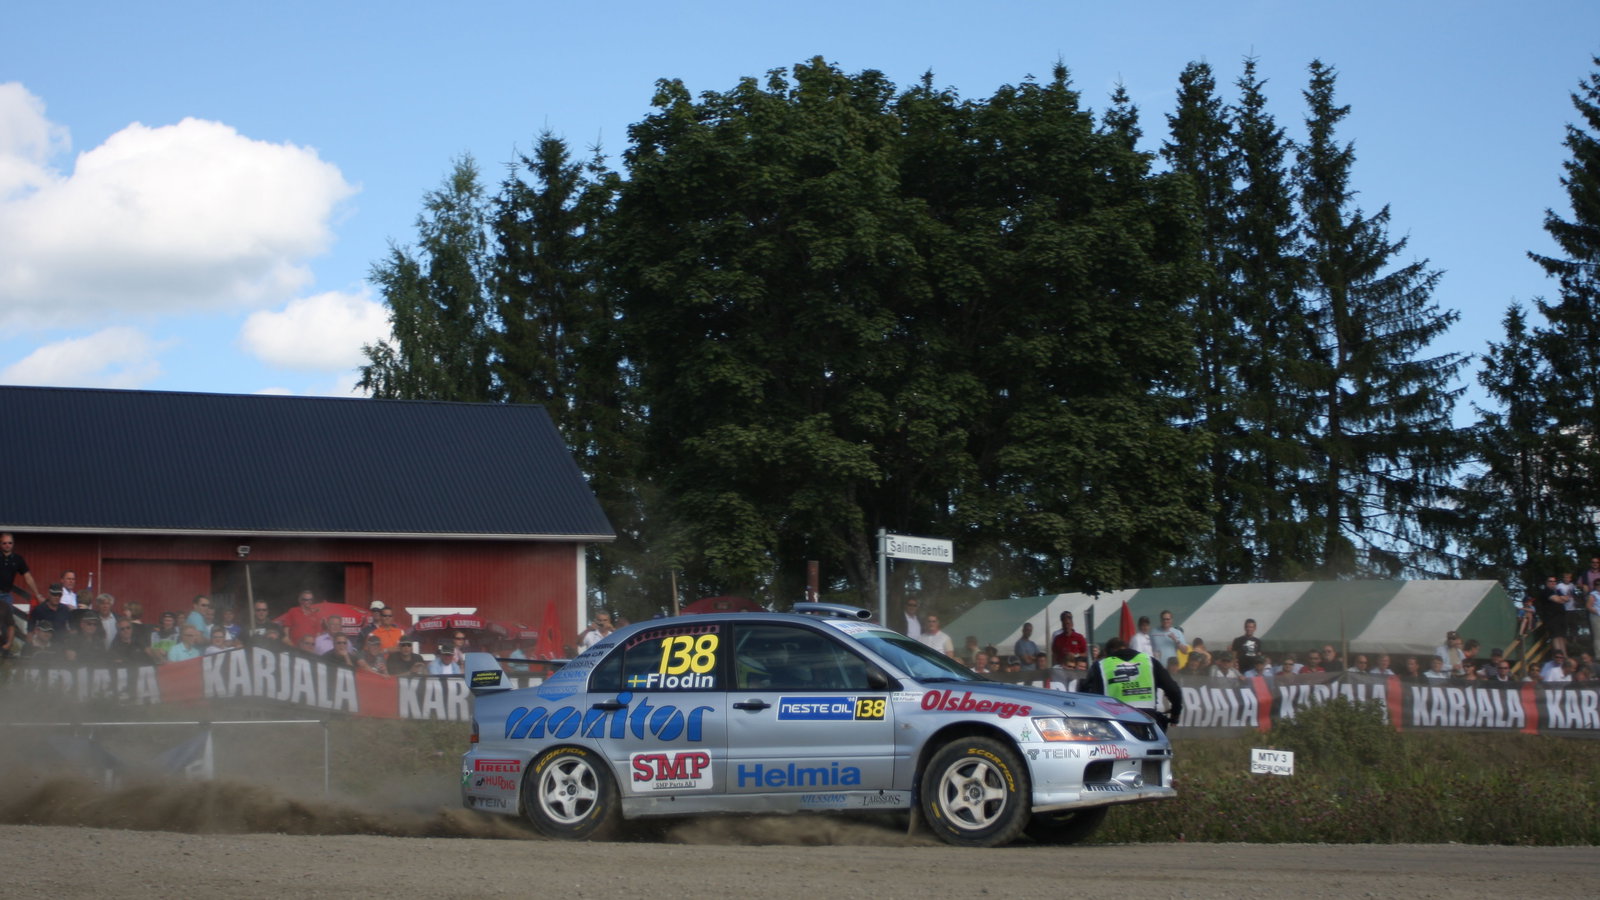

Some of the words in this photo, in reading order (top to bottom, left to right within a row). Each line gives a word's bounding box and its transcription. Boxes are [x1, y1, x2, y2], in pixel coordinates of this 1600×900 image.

[890, 540, 949, 557] Salinmäentie
[660, 635, 719, 675] 138
[203, 647, 358, 712] KARJALA
[646, 672, 714, 689] Flodin
[781, 704, 829, 713] NESTE
[831, 704, 852, 713] OIL
[856, 699, 886, 717] 138
[920, 689, 1032, 719] Olsbergs
[1412, 686, 1525, 728] KARJALA
[505, 691, 715, 743] monitor
[475, 759, 521, 772] PIRELLI
[535, 748, 587, 774] SCORPION
[1042, 749, 1080, 759] TEIN
[1259, 752, 1279, 762] MTV
[1281, 754, 1287, 763] 3
[632, 752, 710, 782] SMP
[738, 762, 861, 787] Helmia
[967, 748, 1015, 793] SCORPION
[478, 798, 507, 808] TEIN
